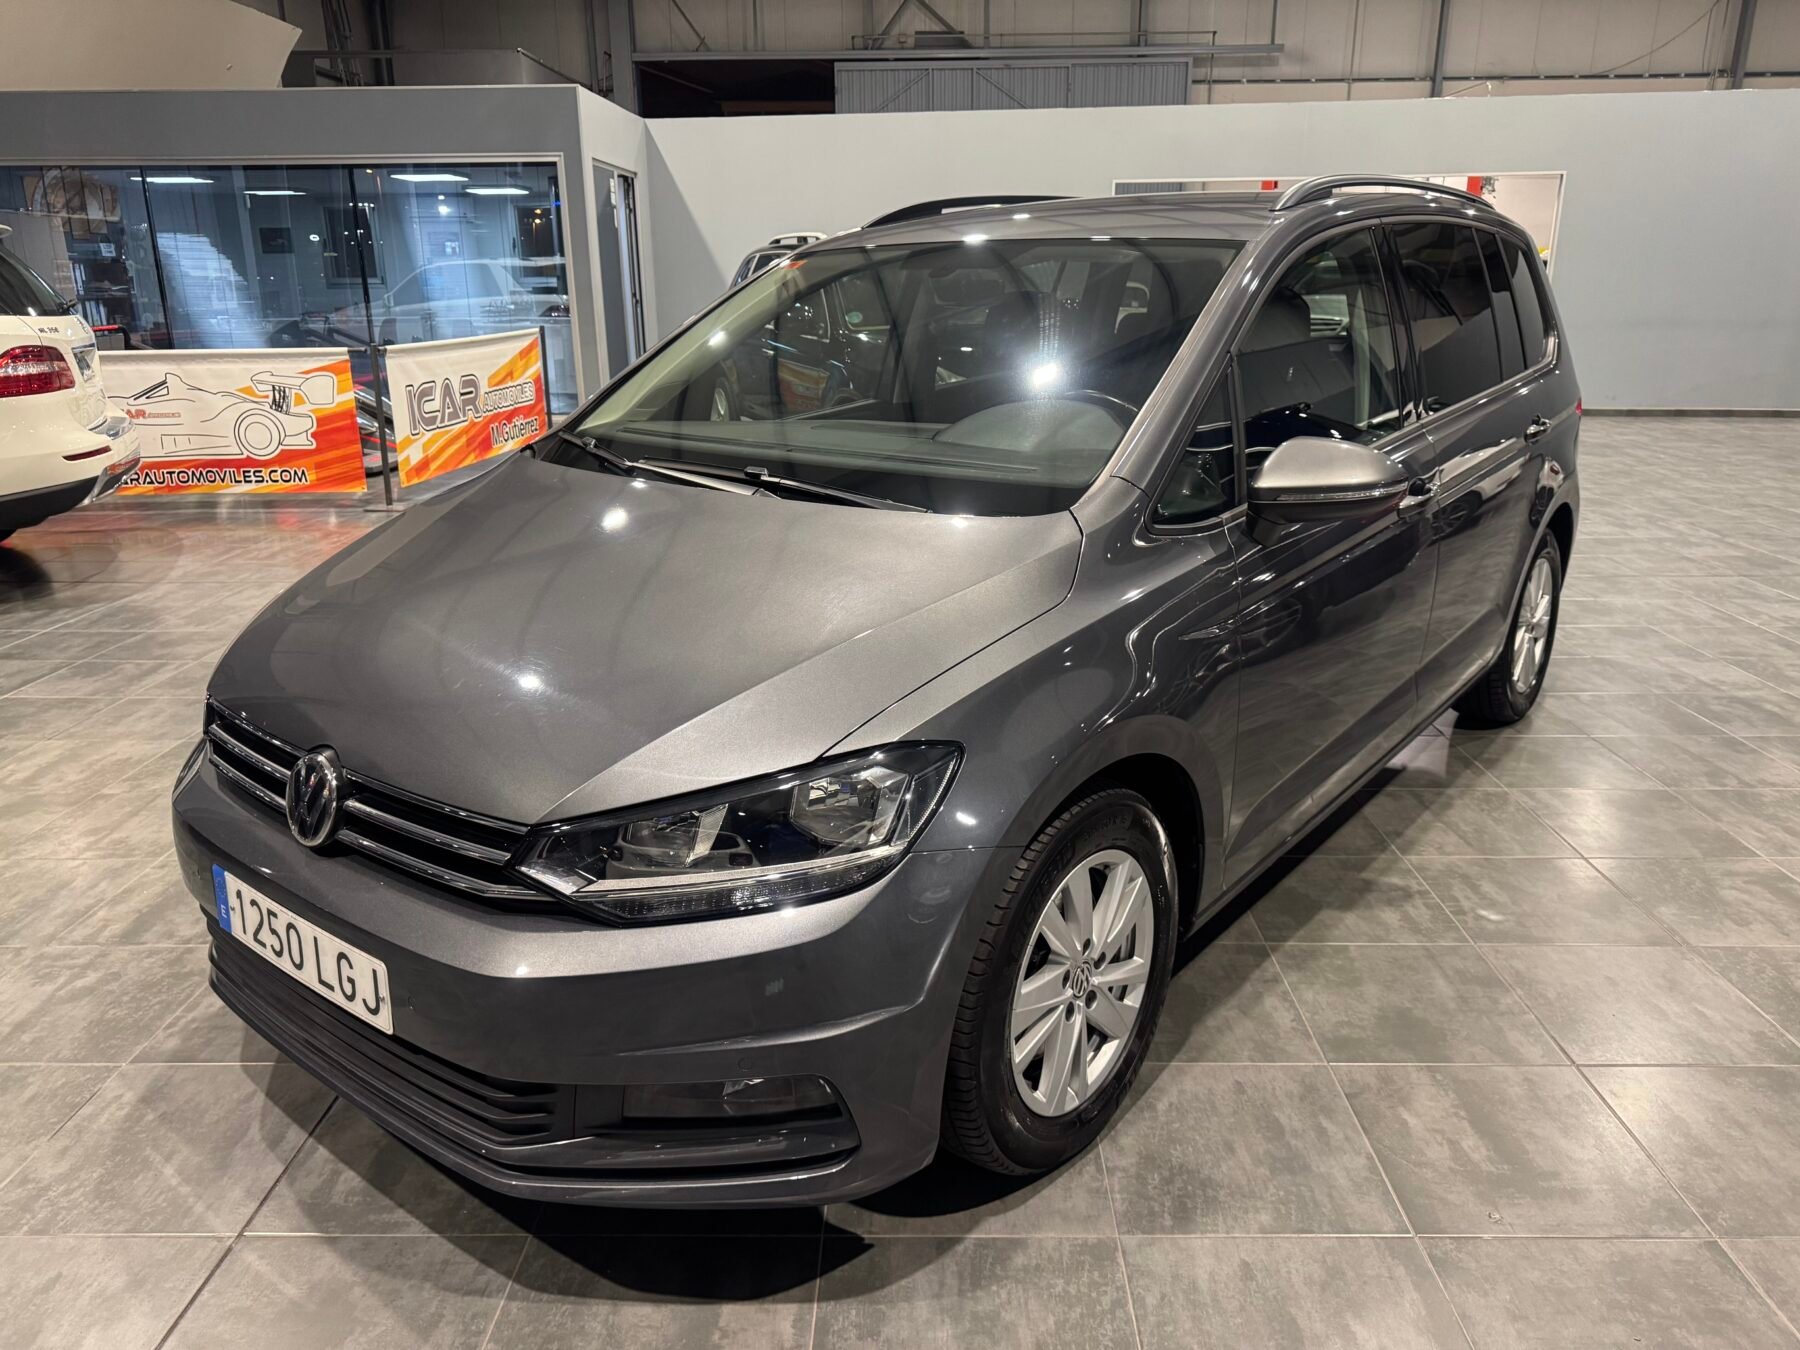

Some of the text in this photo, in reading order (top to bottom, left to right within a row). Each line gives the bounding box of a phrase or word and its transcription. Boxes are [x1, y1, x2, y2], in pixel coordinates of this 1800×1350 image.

[405, 373, 535, 437] ICAR AUTOMOVILES
[491, 415, 540, 447] M.Gutiérrez
[121, 468, 309, 486] RAUTOMOVILES.COM
[235, 888, 382, 1016] 1250 LGJ
